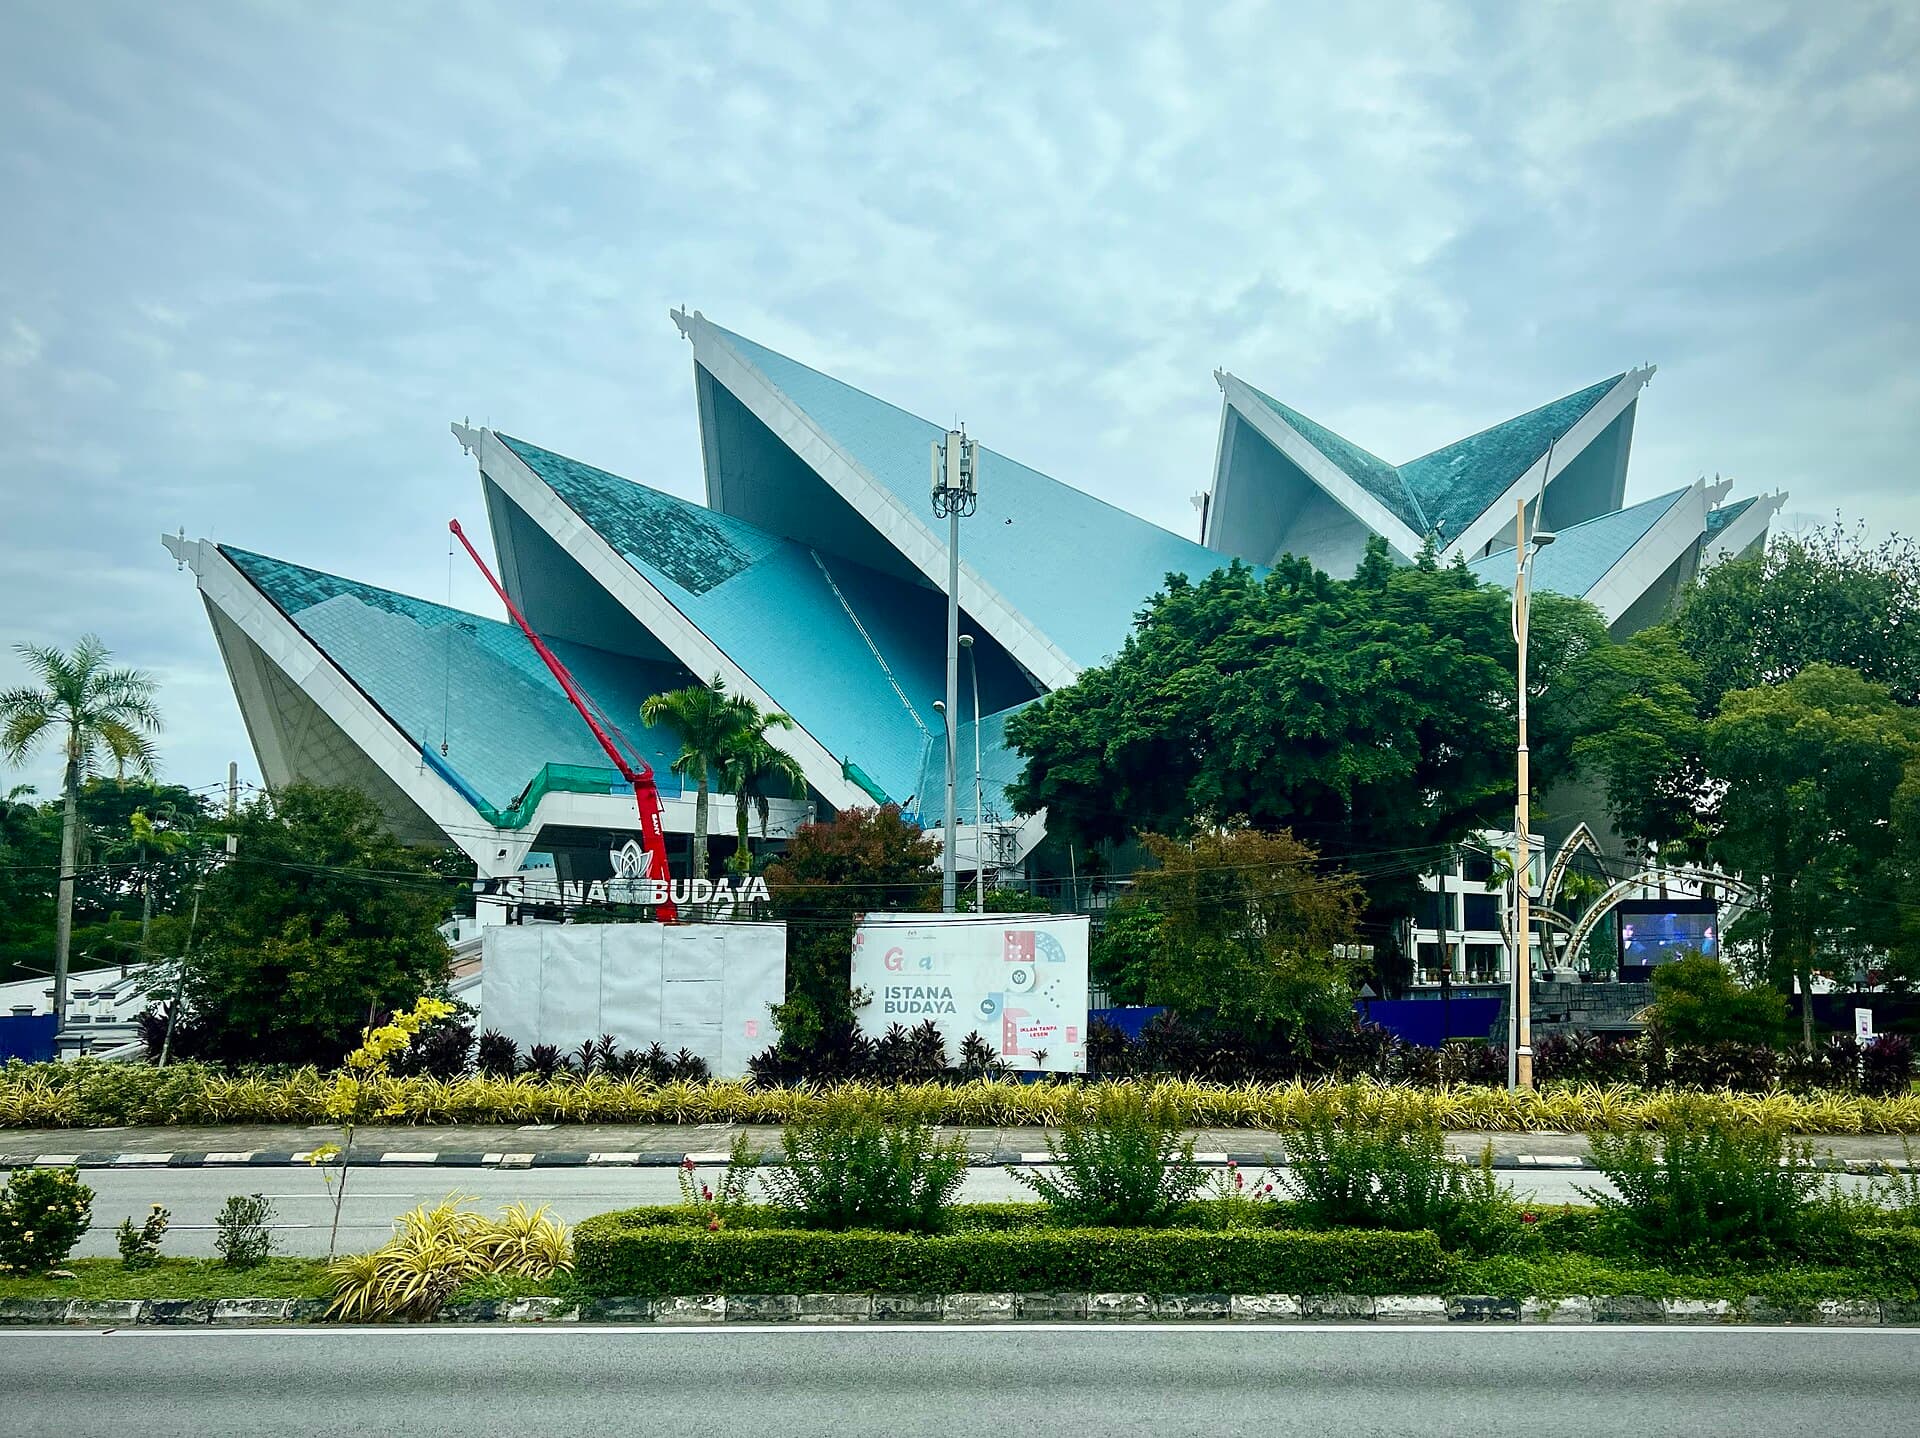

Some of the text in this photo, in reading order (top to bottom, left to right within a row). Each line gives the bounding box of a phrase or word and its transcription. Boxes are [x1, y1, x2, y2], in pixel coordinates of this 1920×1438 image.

[650, 876, 771, 905] BUDAYA
[884, 986, 953, 999] ISTANA
[884, 1001, 957, 1014] BUDAYA
